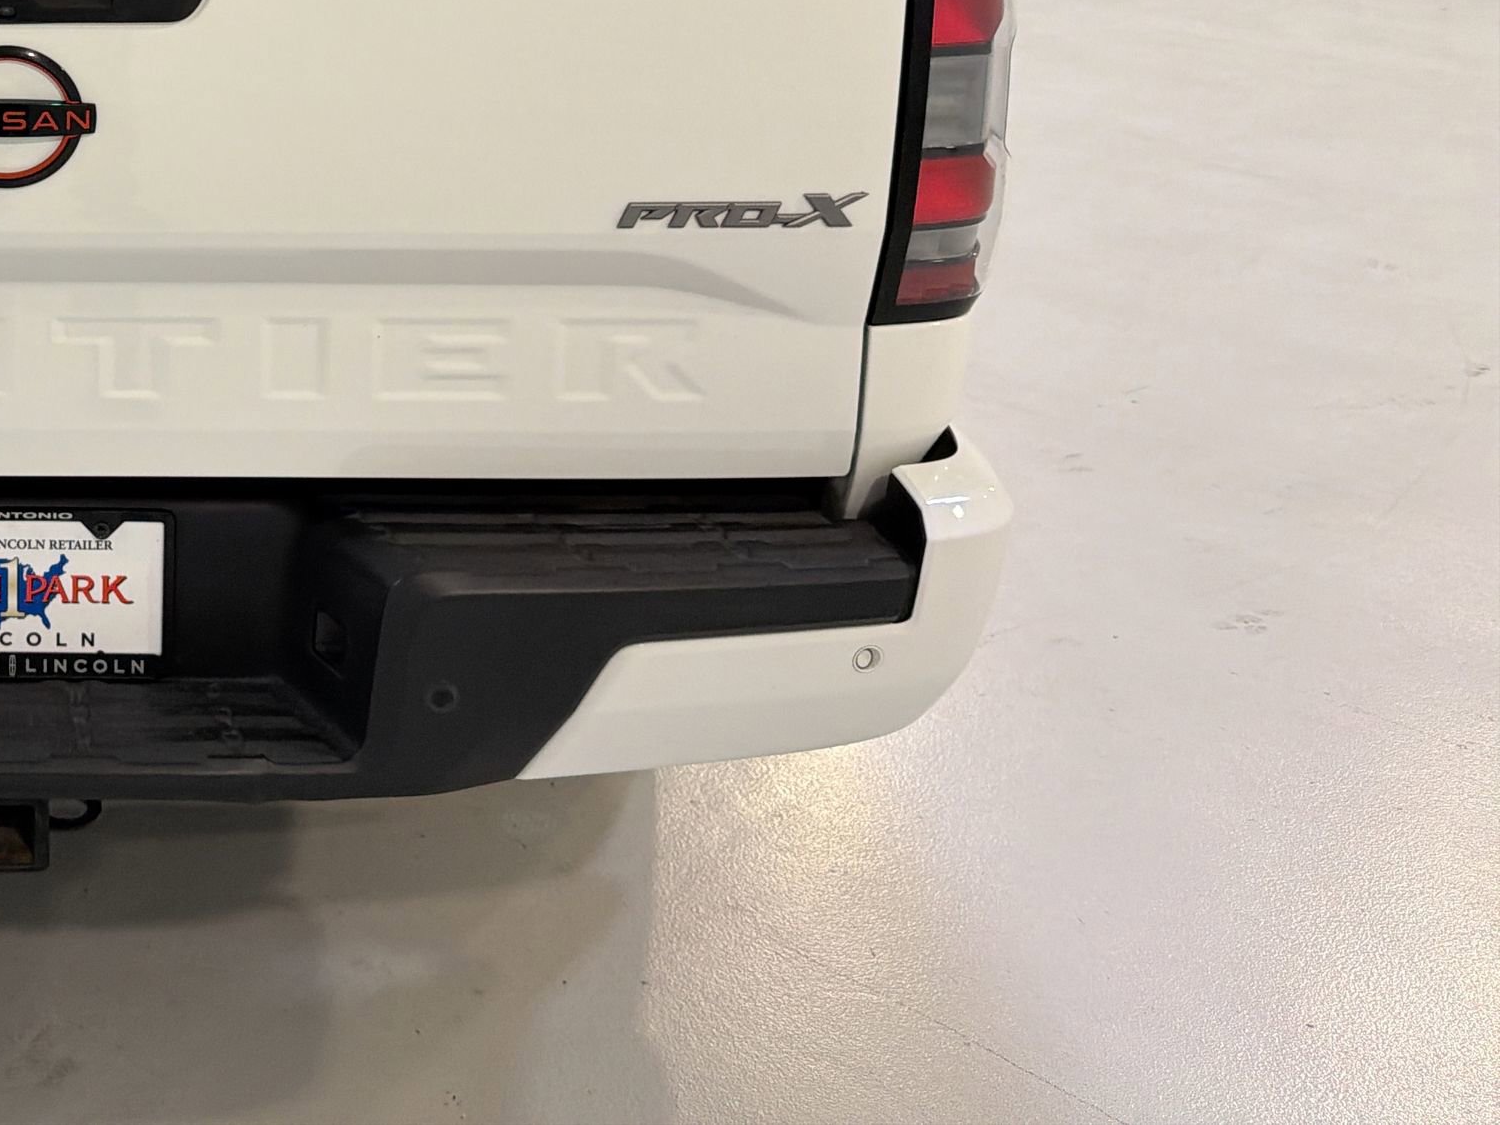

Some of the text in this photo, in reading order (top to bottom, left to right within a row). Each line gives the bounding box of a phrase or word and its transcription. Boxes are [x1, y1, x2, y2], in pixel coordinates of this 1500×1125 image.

[49, 539, 113, 551] RETAILER
[25, 575, 134, 605] PARK
[25, 658, 145, 675] LINCOLN
